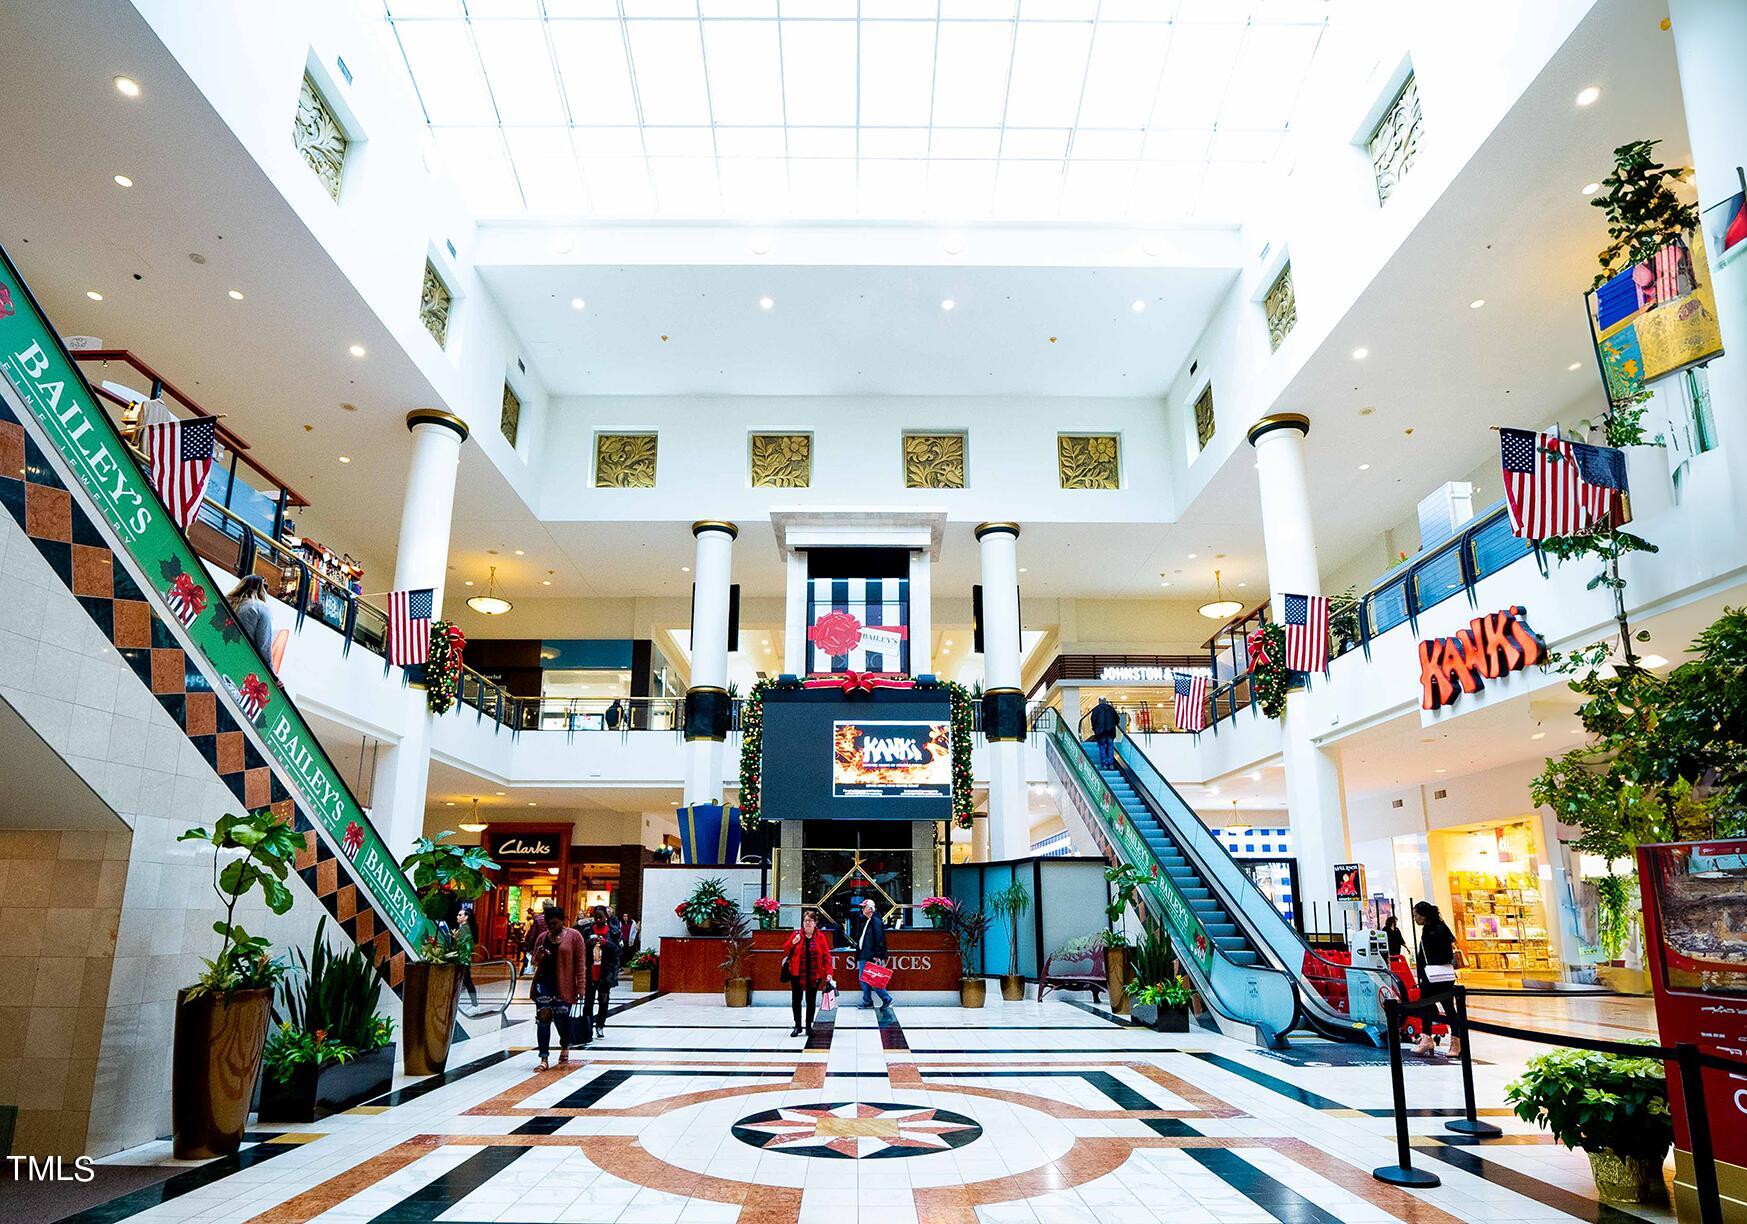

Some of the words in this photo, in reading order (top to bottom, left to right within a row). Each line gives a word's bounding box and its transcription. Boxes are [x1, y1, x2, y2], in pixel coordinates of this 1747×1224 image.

[15, 339, 151, 534] BAILEY'S
[1100, 667, 1160, 680] JOHNSTON
[273, 715, 345, 821] BAILEY'S
[499, 839, 551, 854] Clarks
[365, 848, 418, 927] BAILEY'S
[1160, 876, 1190, 927] BAILEY'S
